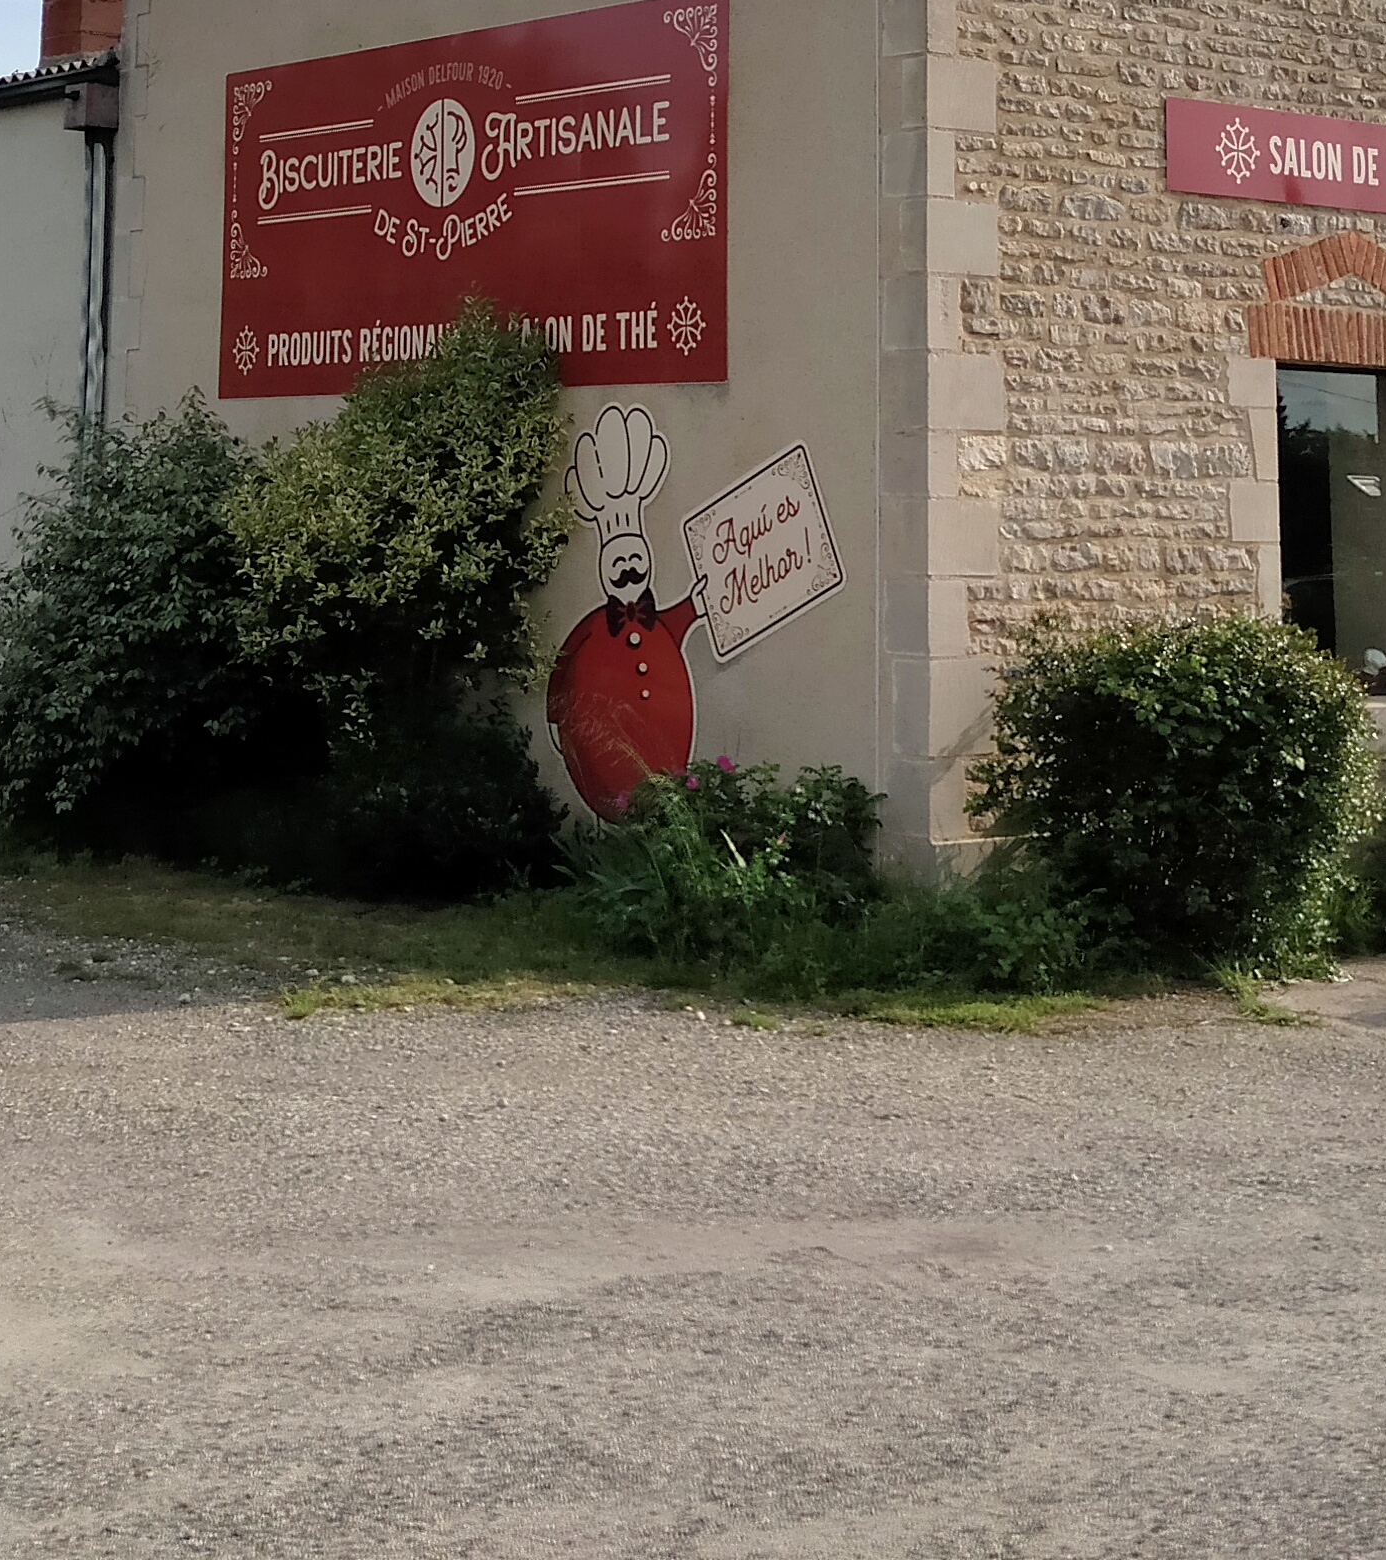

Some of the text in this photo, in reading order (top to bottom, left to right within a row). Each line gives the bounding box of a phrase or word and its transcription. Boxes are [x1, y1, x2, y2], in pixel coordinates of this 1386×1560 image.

[385, 62, 504, 109] MAISON DELFOUR 1920
[258, 100, 670, 210] BISCUITERIE ARTISANALE
[1269, 135, 1342, 182] SALON
[1352, 146, 1379, 186] DE
[374, 209, 400, 244] DE
[267, 328, 353, 367] PRODUITS
[582, 313, 607, 352] DE
[615, 301, 658, 350] THÉ
[712, 495, 800, 564] Aquí es
